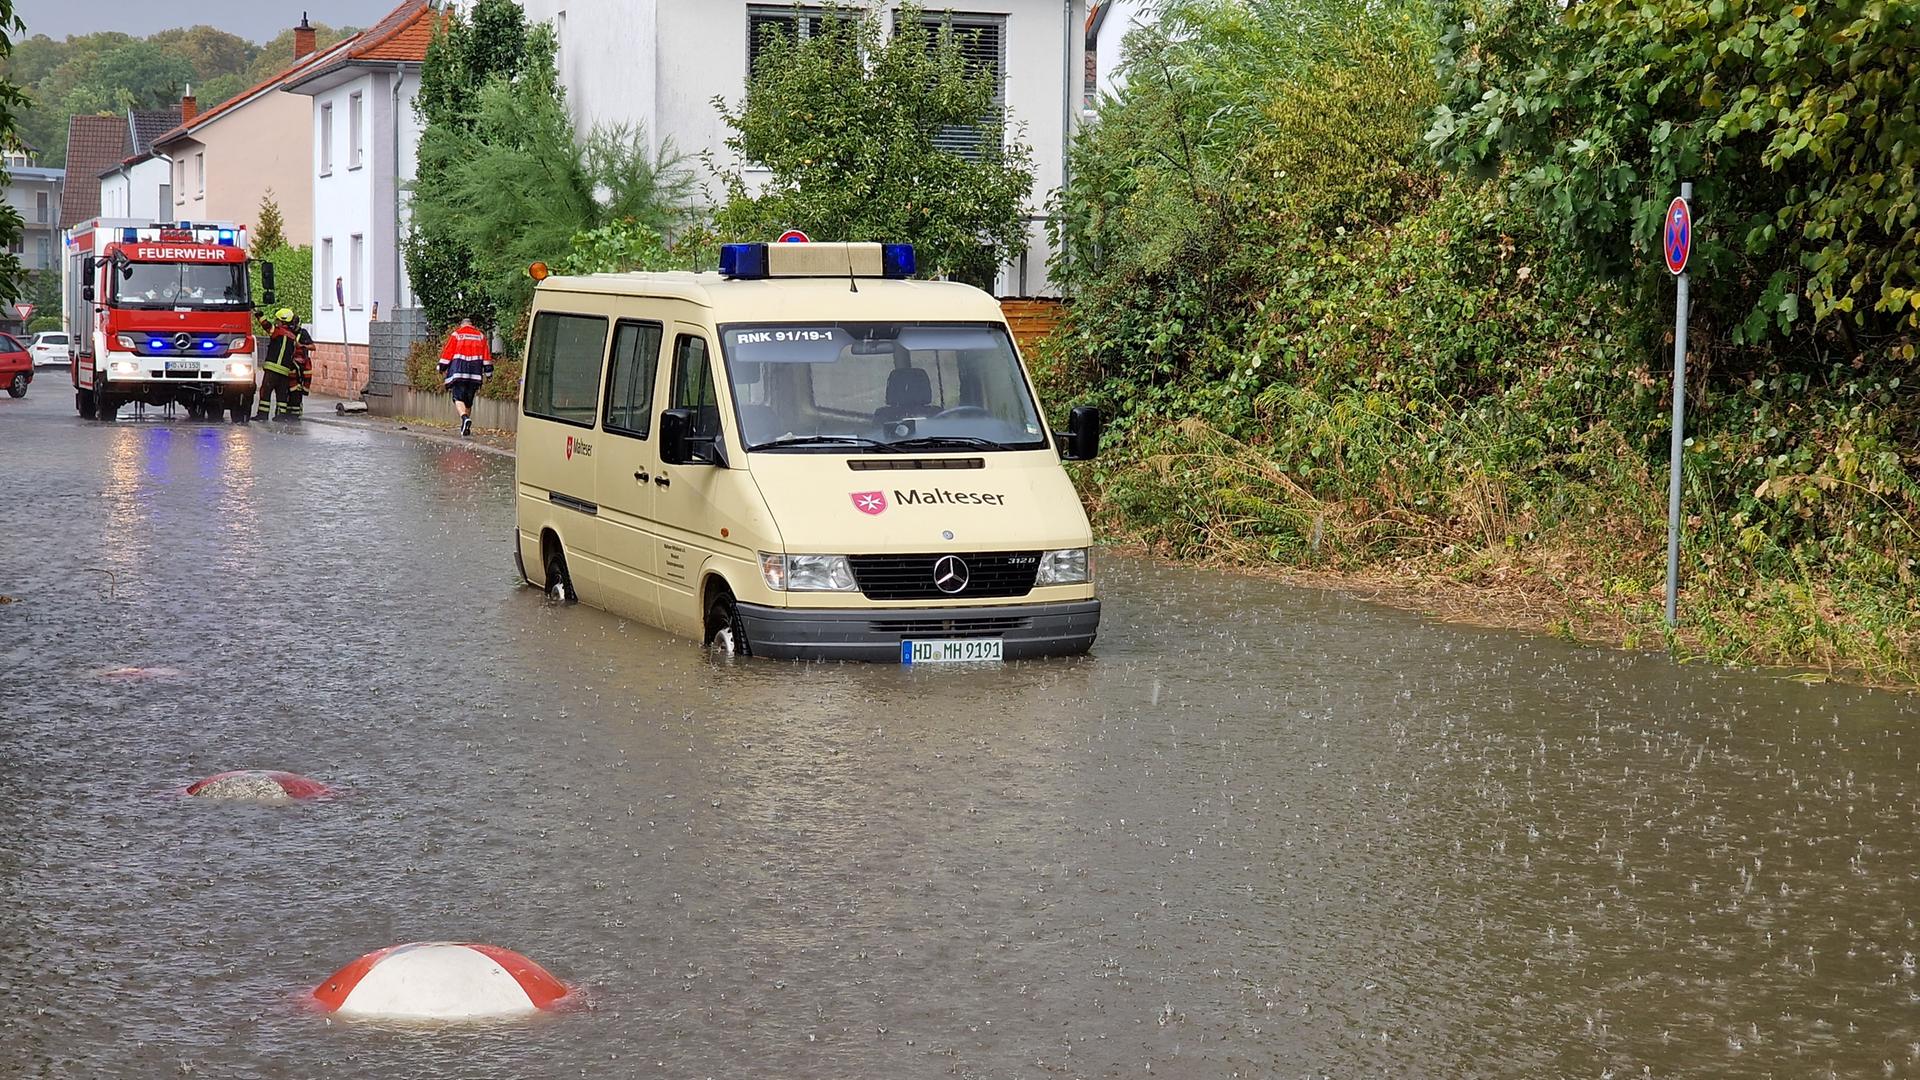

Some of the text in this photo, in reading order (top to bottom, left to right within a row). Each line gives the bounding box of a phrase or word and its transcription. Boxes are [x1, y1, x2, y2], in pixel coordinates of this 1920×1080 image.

[138, 247, 226, 260] FEUERWEHR
[737, 330, 833, 344] RNK 91/19-1
[893, 488, 1005, 506] Malteser
[913, 641, 1001, 660] HD MH 9191
